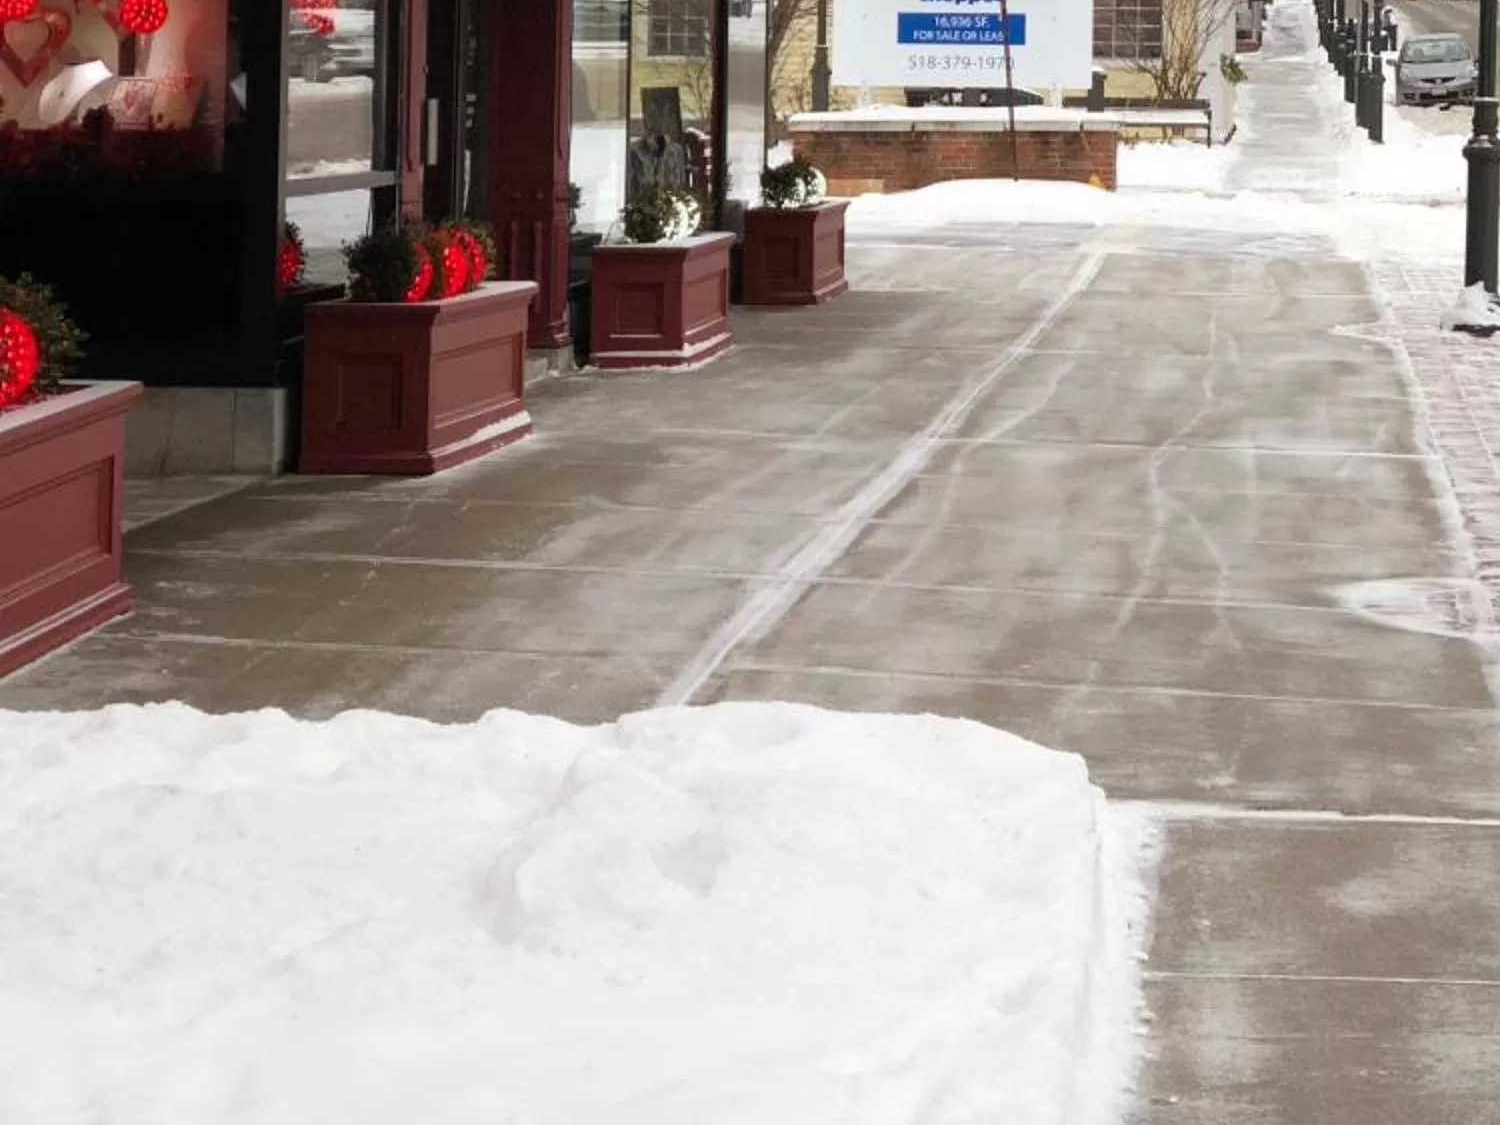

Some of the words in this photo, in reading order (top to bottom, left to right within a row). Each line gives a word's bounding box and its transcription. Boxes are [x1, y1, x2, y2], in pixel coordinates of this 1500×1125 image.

[913, 30, 935, 41] FOR
[936, 30, 961, 42] SALE
[962, 31, 978, 42] OR
[979, 31, 1005, 43] LEAS
